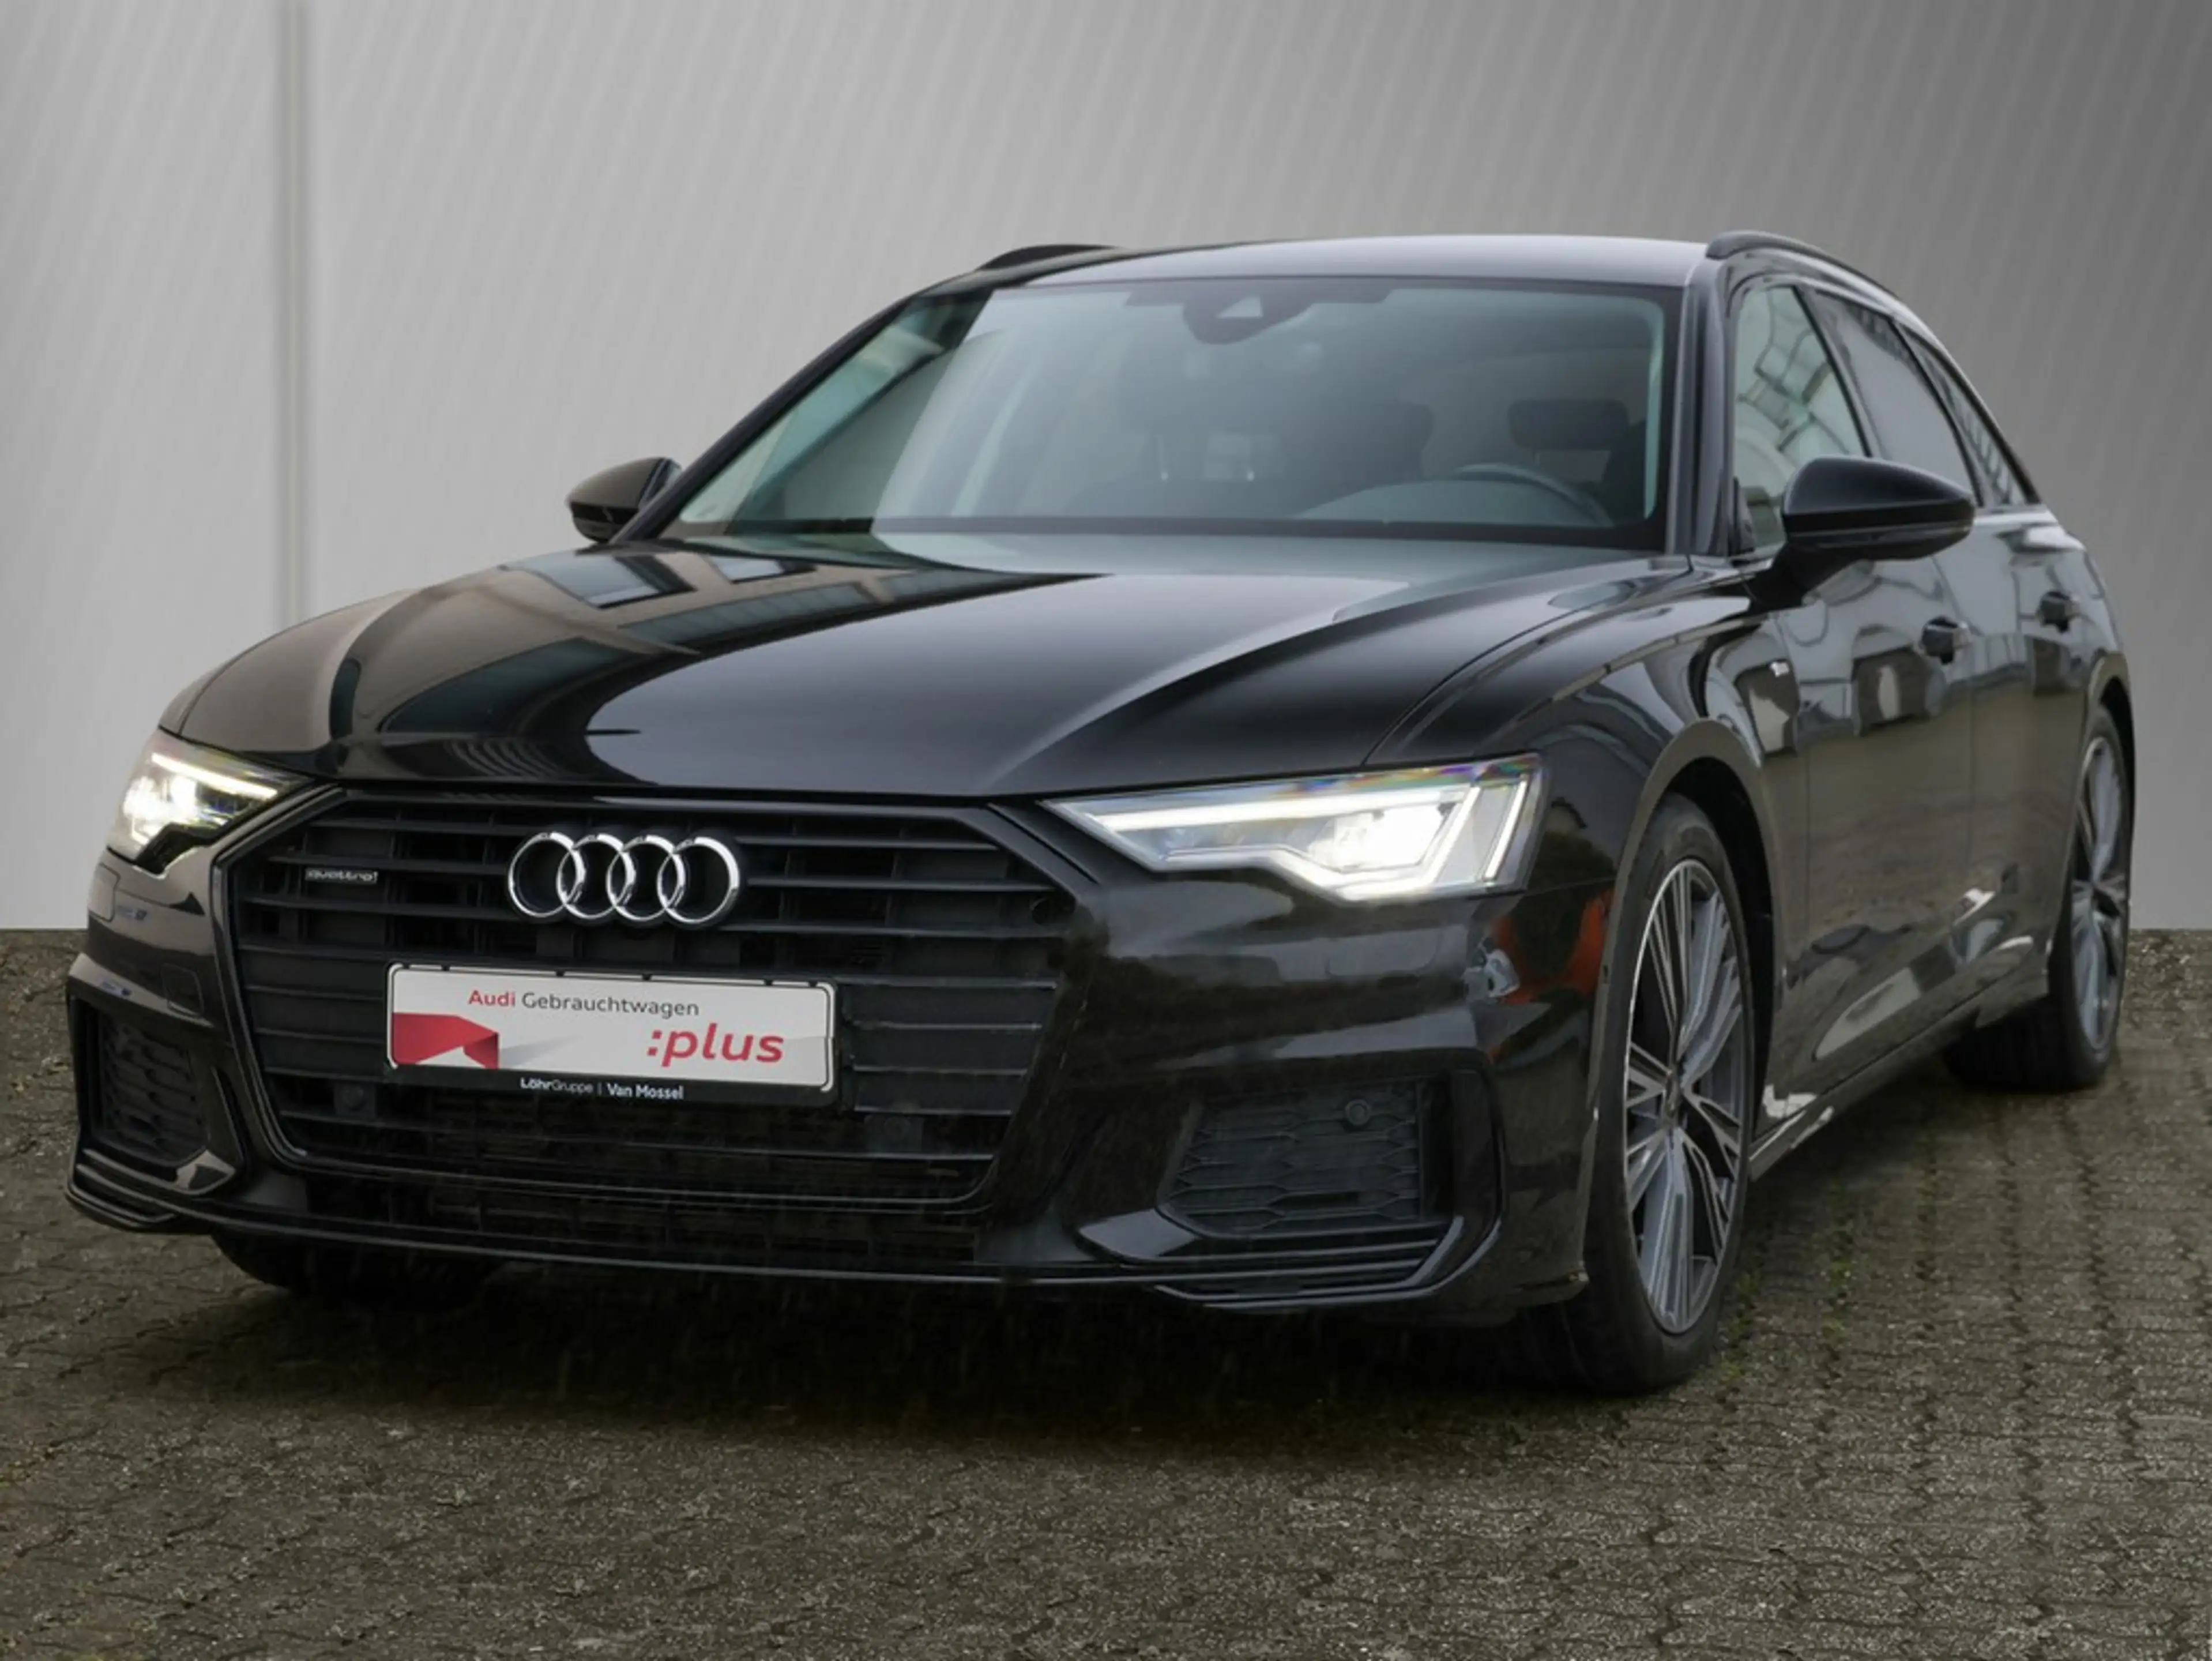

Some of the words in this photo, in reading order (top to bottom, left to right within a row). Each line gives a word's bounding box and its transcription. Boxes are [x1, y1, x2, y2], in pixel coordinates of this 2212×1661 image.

[468, 989, 516, 1007] Audi
[521, 992, 699, 1019] Gebrauchtwagen
[607, 1083, 633, 1097] Van
[635, 1084, 684, 1099] Mossel
